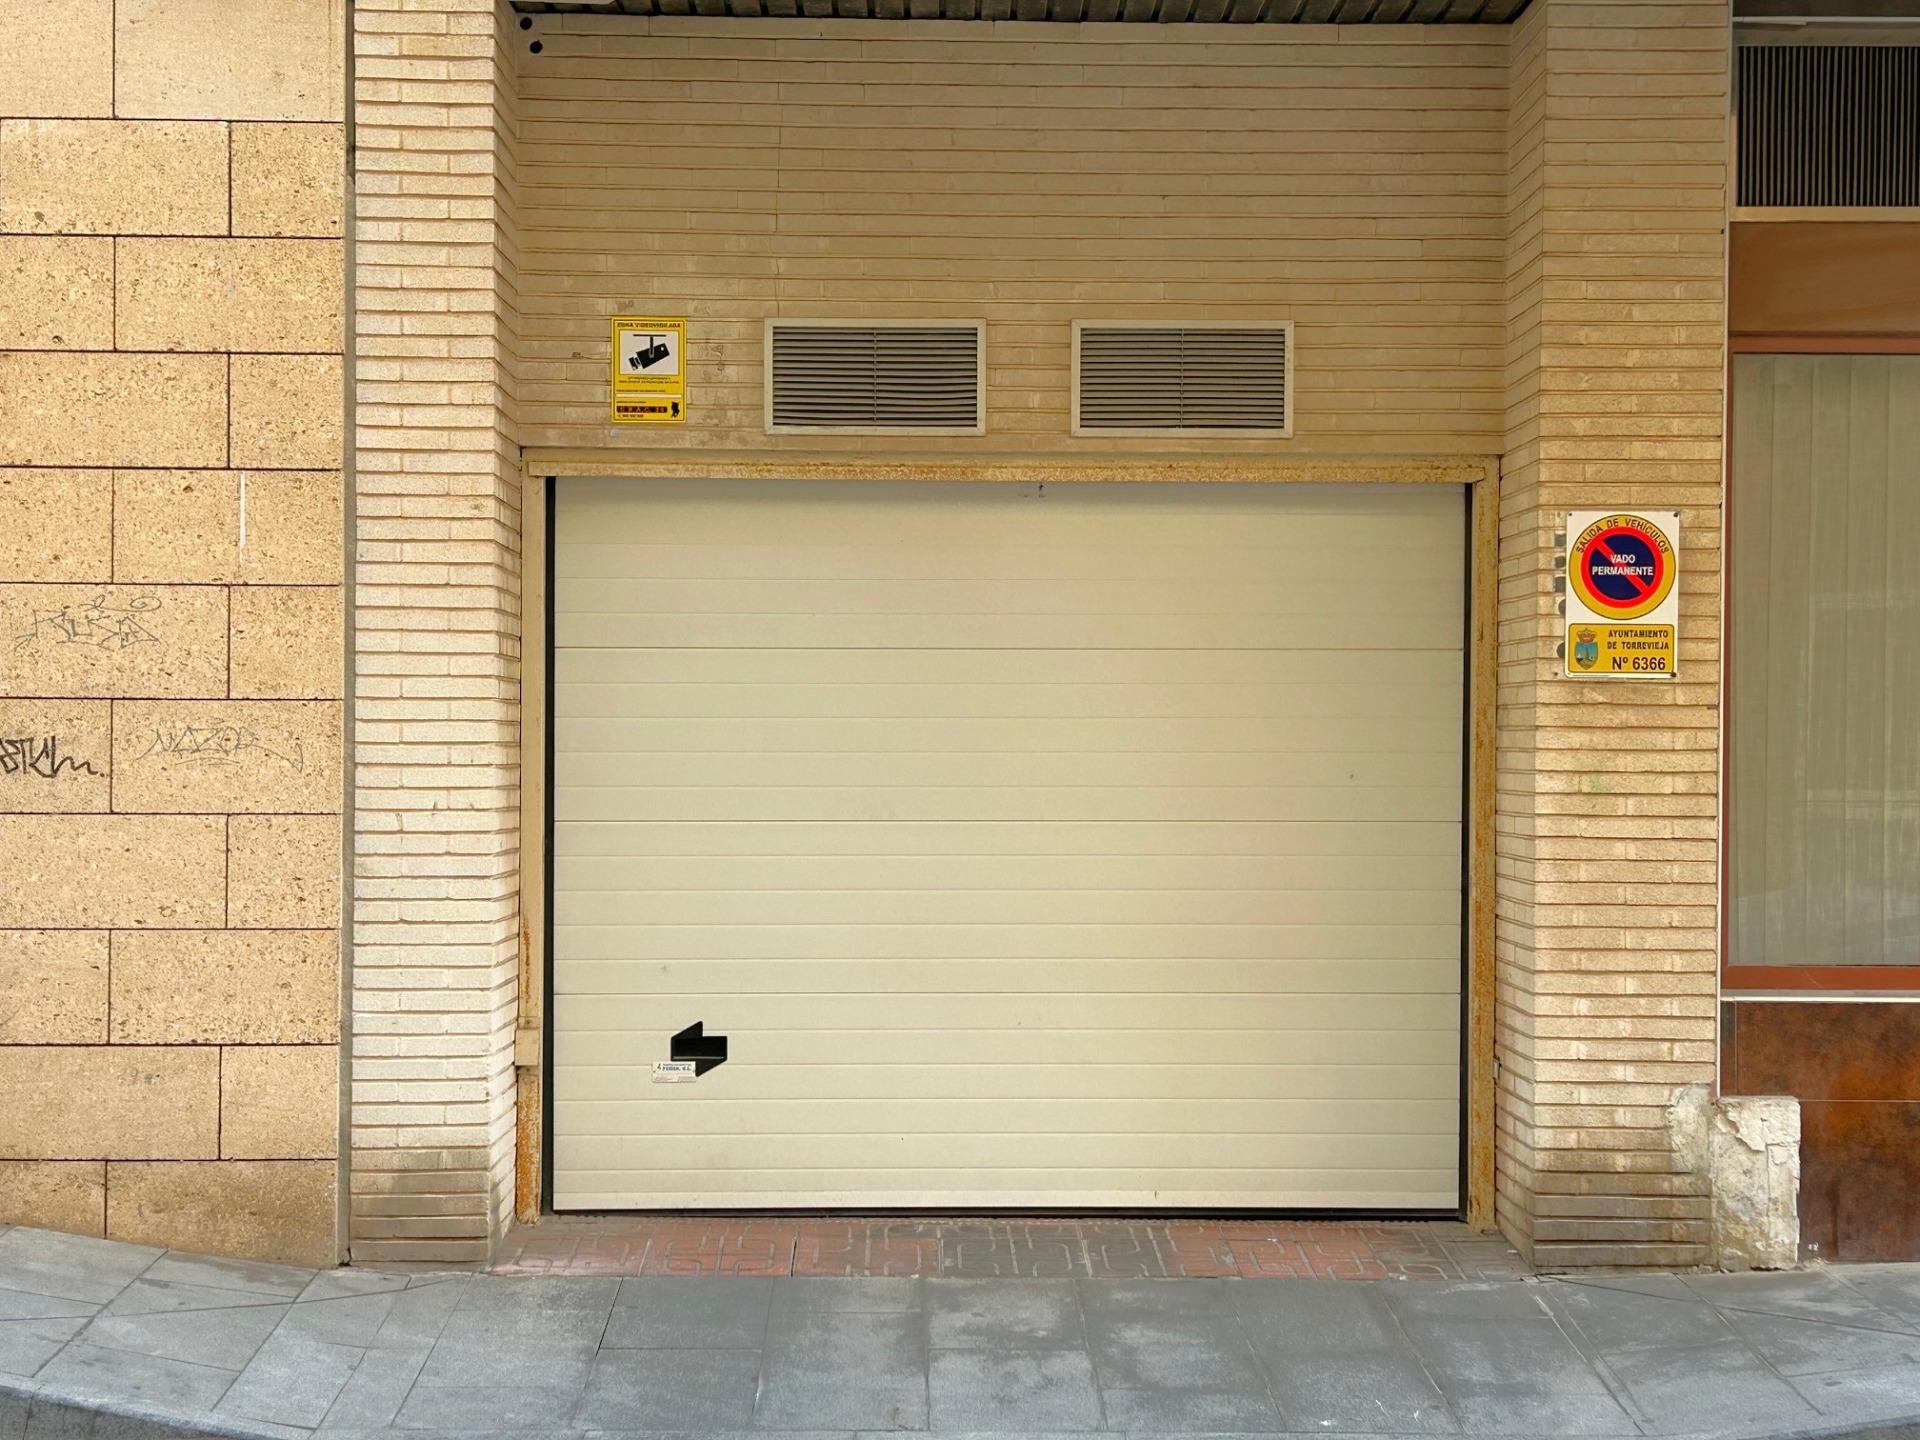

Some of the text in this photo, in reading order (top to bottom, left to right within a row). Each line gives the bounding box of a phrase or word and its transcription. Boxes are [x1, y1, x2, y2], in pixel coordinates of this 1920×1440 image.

[1576, 525, 1603, 553] SALIDA
[1606, 518, 1619, 528] DE
[1610, 554, 1636, 564] VADO
[1592, 566, 1654, 576] PERMANENTE
[1608, 629, 1669, 638] AYUNTAMIENTO
[1607, 641, 1669, 650] DE TORREVIEJA
[1632, 656, 1666, 671] 6366
